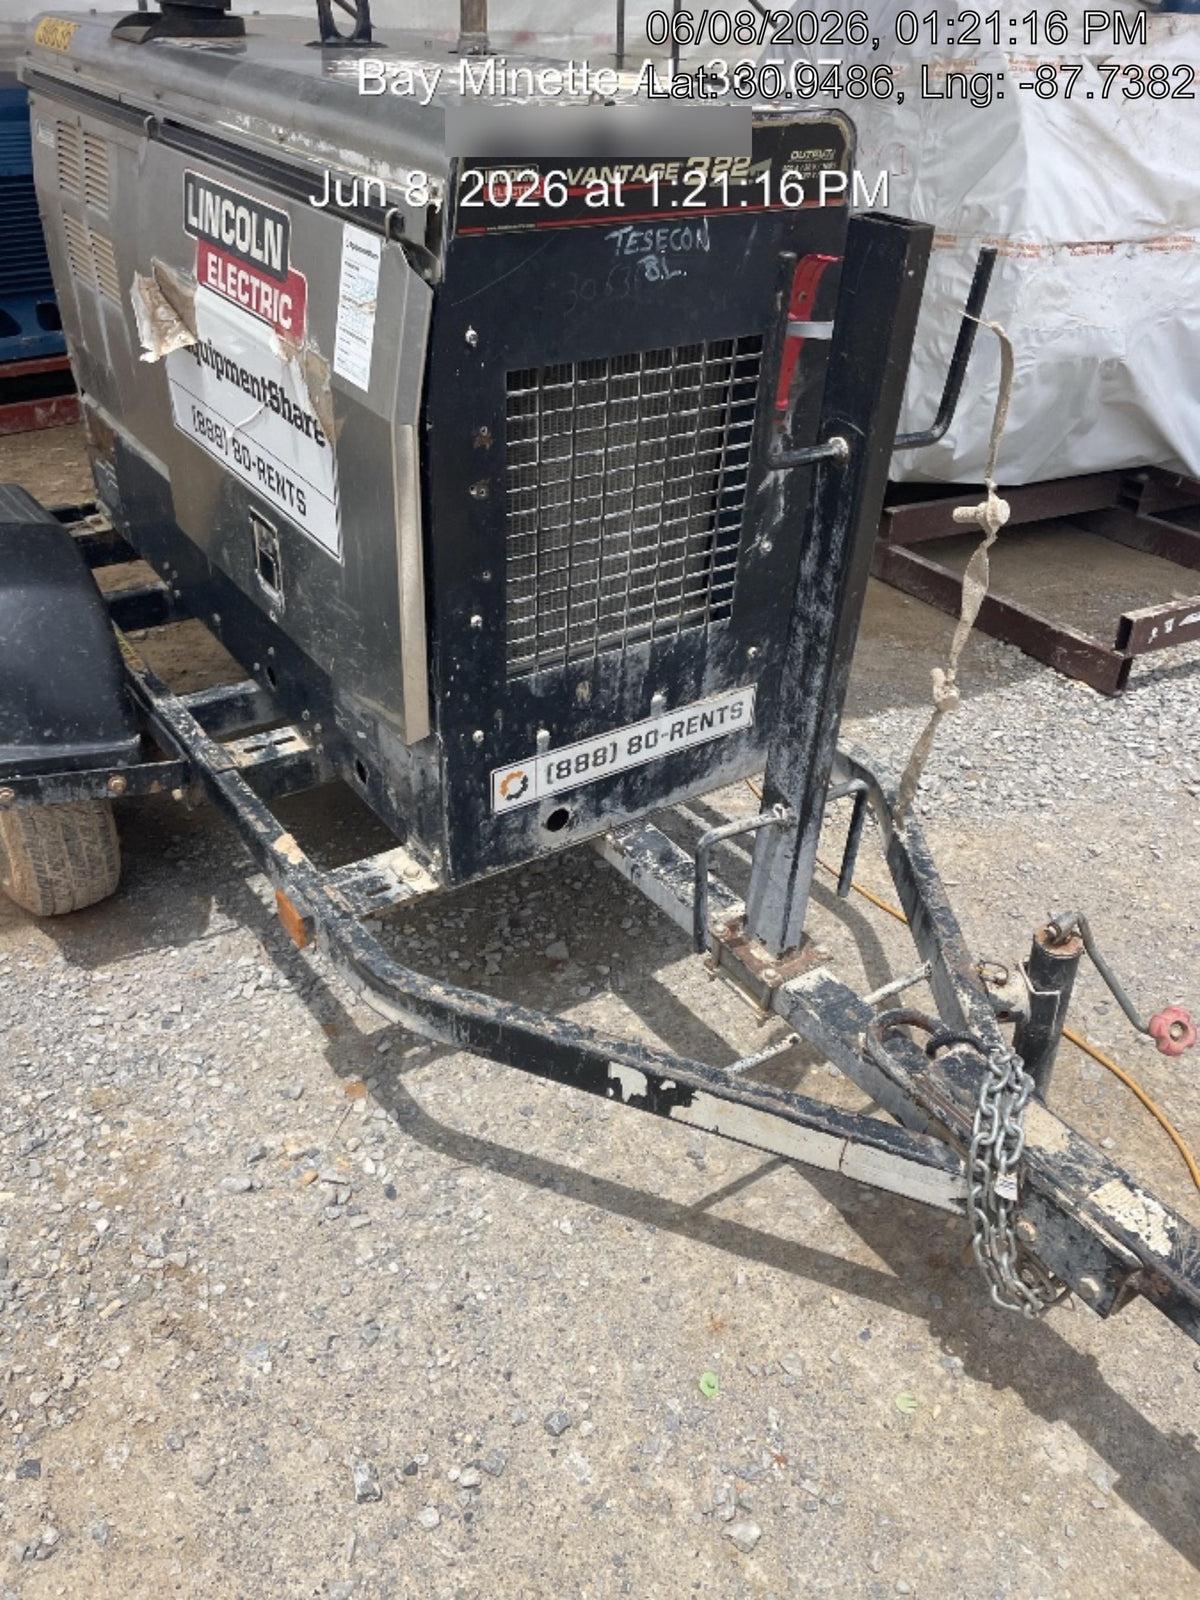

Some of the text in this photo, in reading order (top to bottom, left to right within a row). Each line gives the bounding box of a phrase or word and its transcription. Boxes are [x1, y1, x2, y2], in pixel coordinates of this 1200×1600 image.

[567, 163, 680, 186] VANTAGE
[187, 182, 283, 272] LINCOLN
[207, 252, 292, 330] ELECTRIC
[191, 405, 307, 517] (888) 80-RENTS
[546, 701, 744, 785] (888) 80-RENTS
